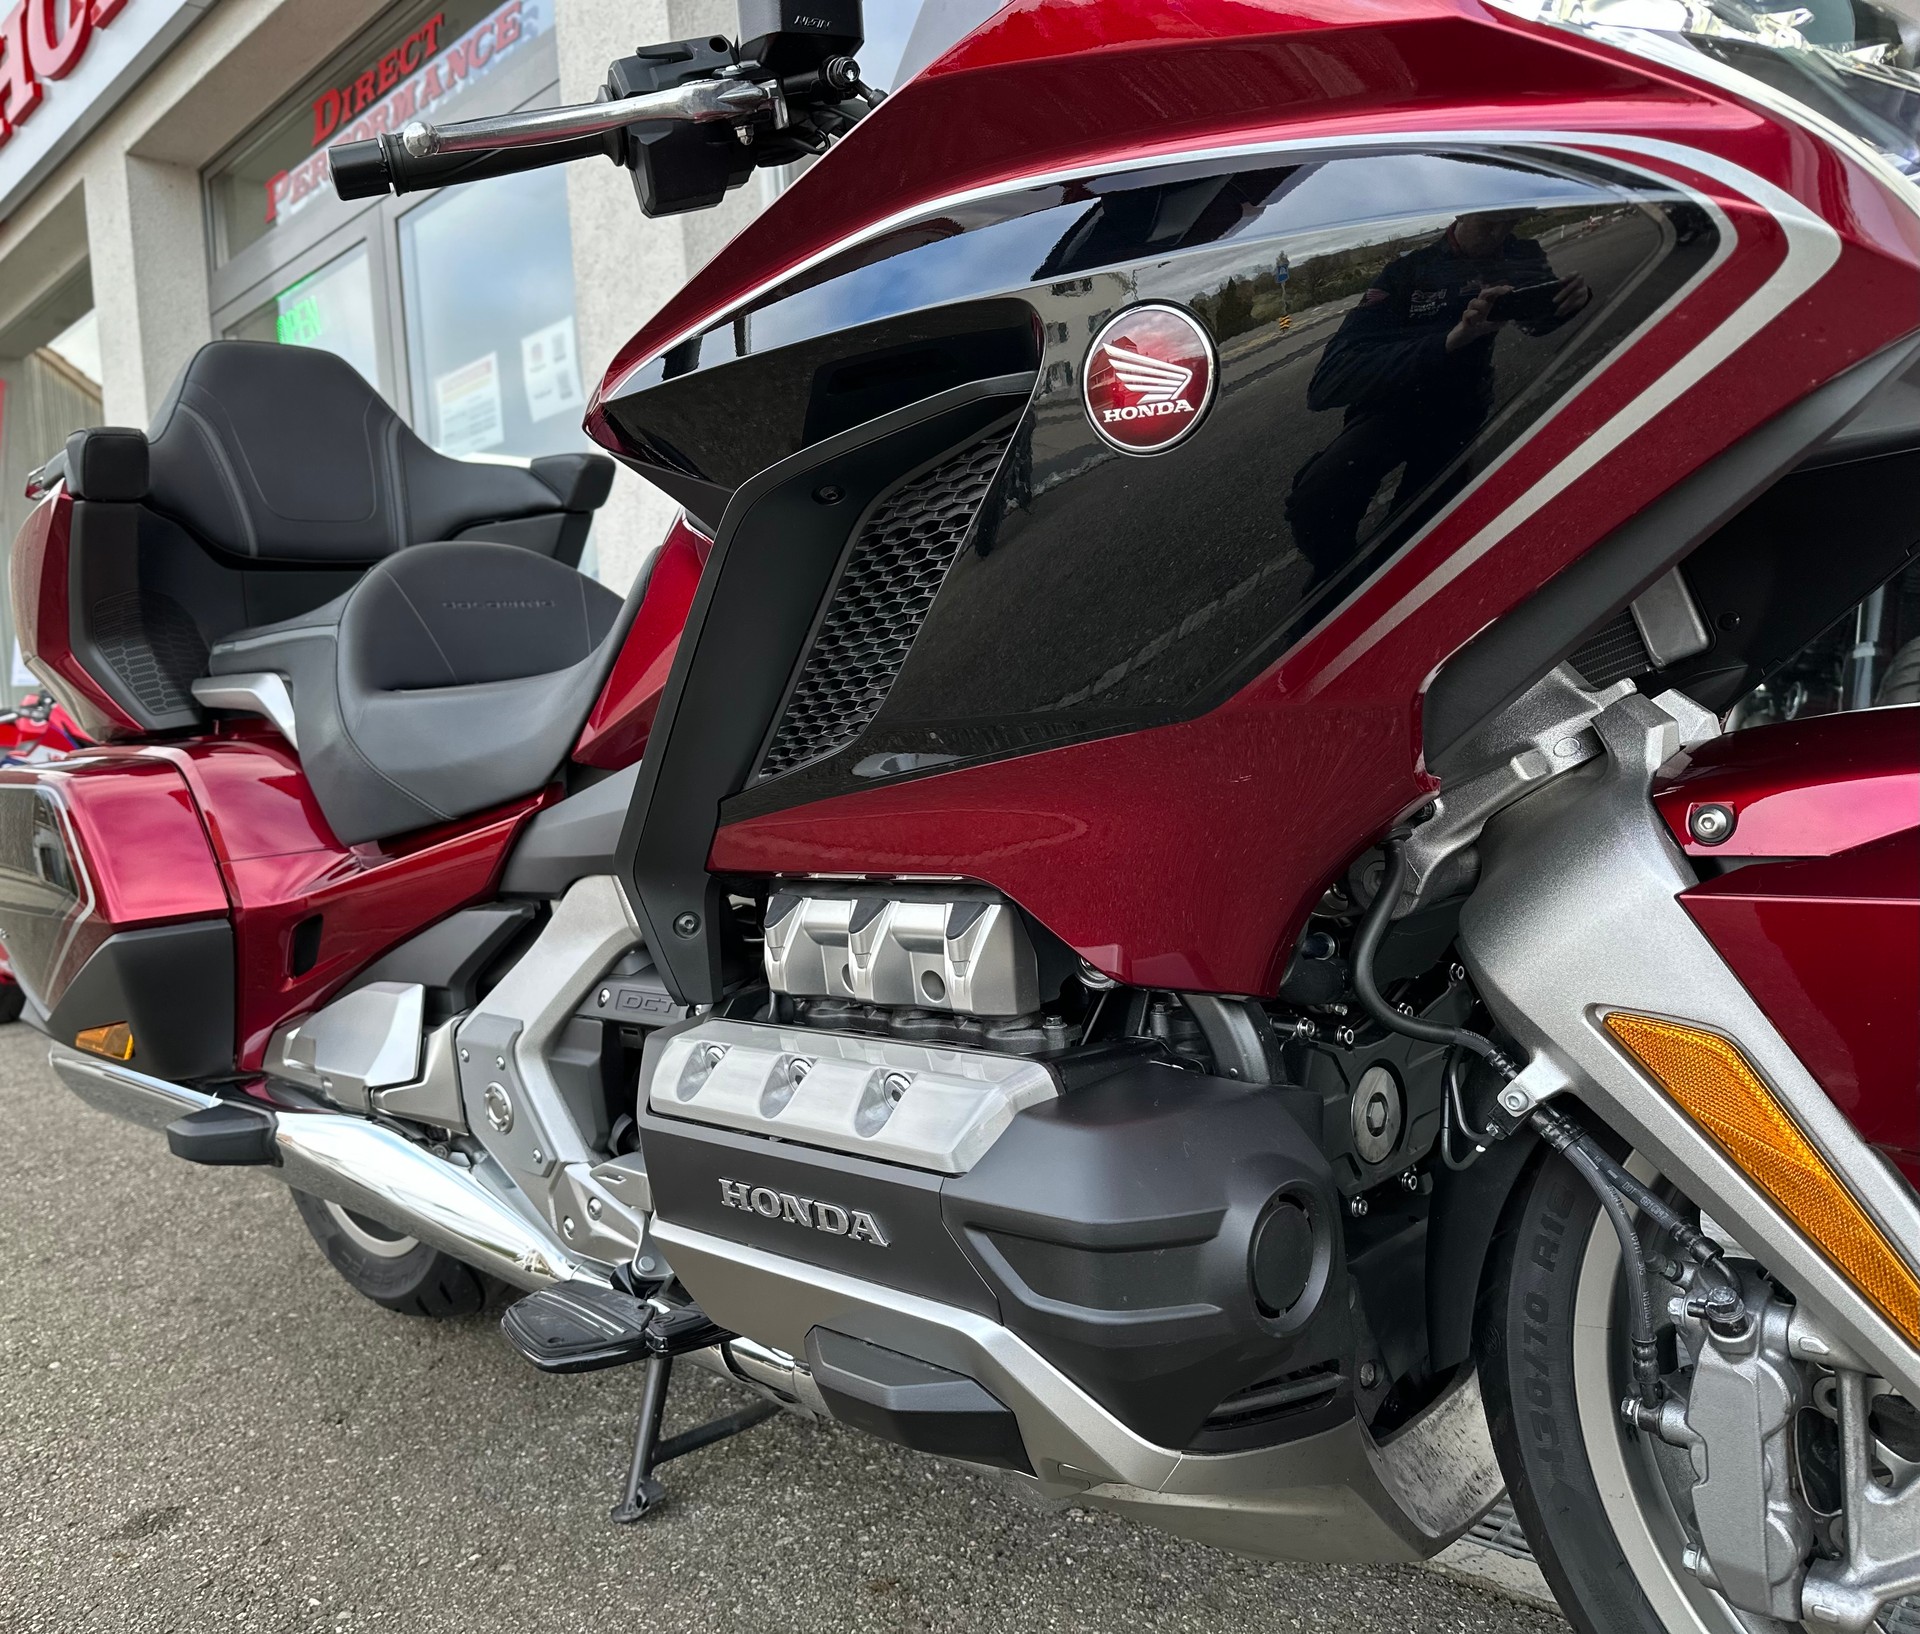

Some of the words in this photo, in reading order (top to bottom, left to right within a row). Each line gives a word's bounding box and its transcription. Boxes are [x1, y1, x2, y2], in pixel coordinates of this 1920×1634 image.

[311, 12, 445, 147] DIRECT
[1103, 399, 1195, 423] HONDA
[622, 995, 676, 1014] DCT
[718, 1176, 892, 1248] HONDA
[1621, 1181, 1638, 1195] DOT
[1522, 1288, 1565, 1464] 130/70
